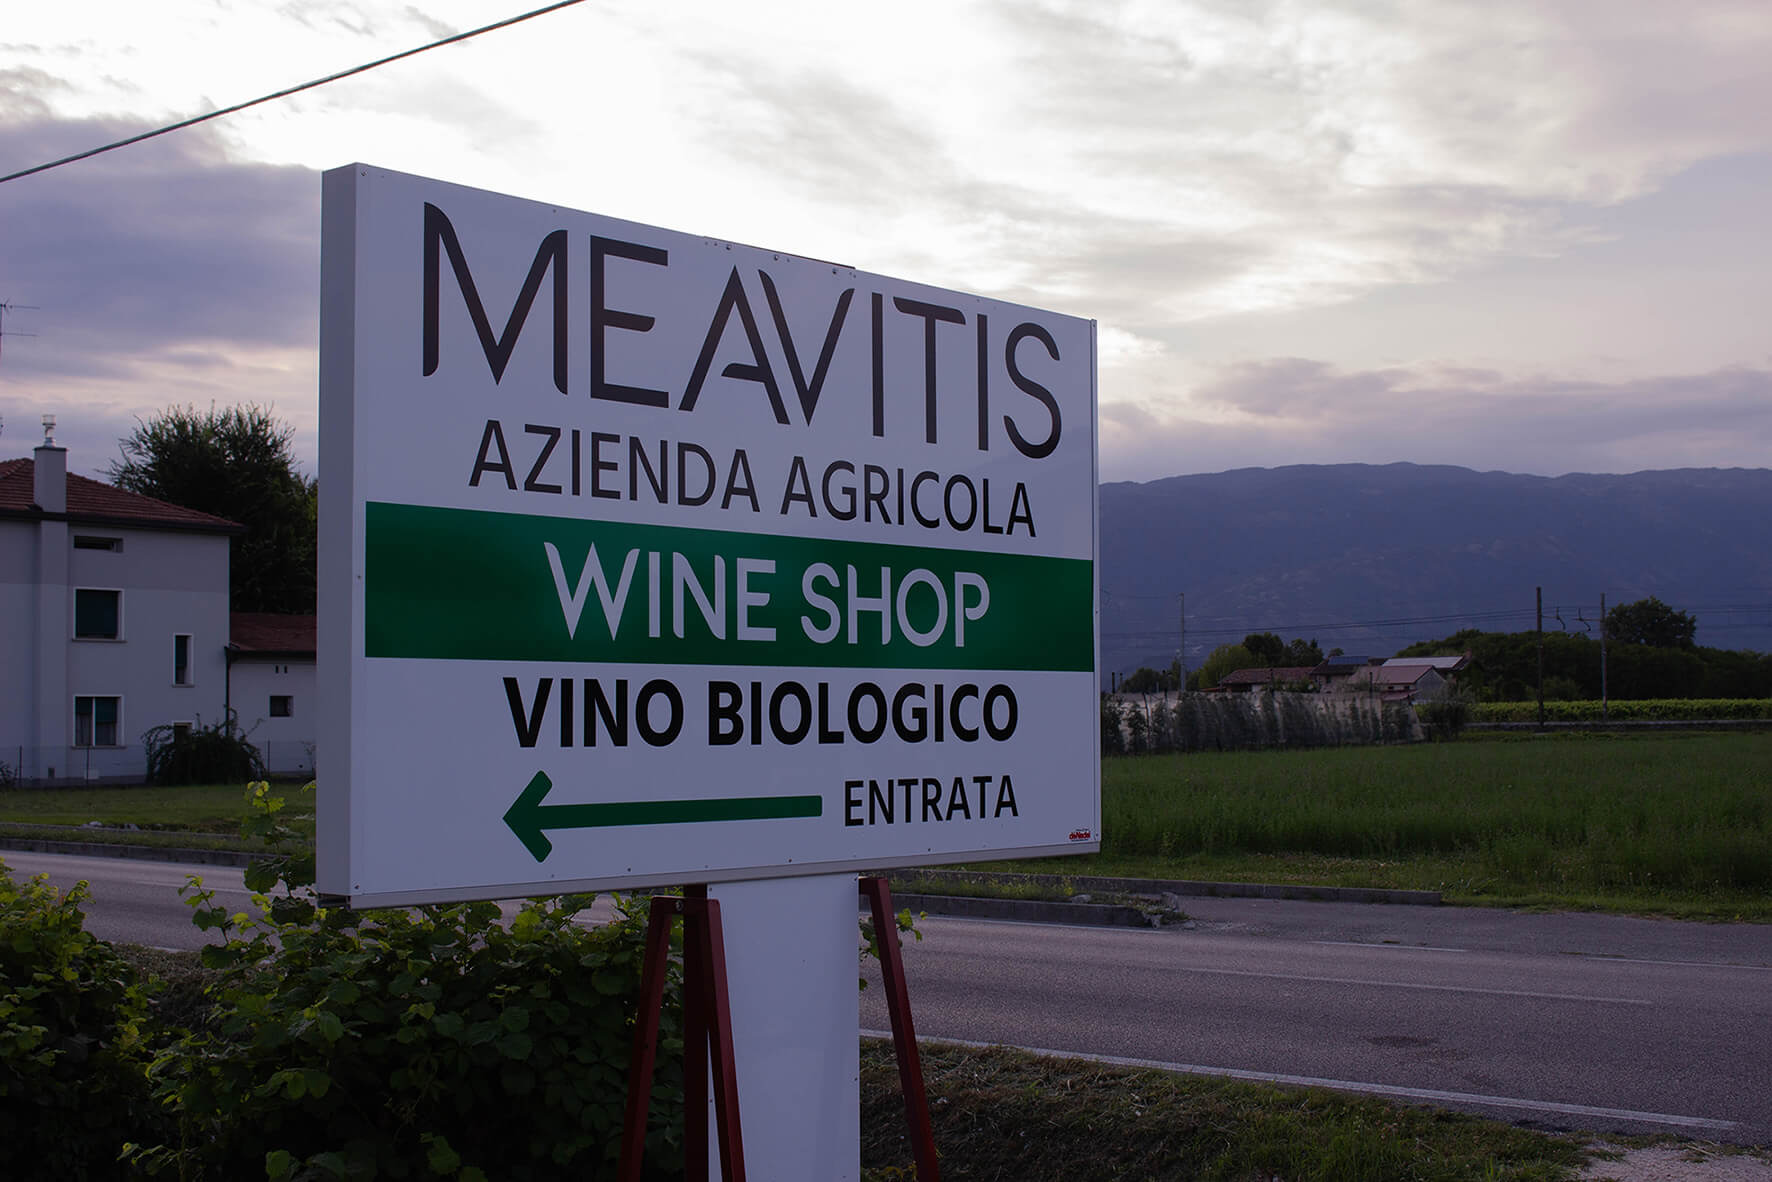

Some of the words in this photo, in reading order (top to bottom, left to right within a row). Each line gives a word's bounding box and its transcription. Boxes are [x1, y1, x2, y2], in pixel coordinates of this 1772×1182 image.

[423, 202, 1061, 459] MEAVITIS
[469, 420, 760, 512] AZIENDA
[781, 456, 1036, 537] AGRICOLA
[544, 542, 776, 641] WINE
[801, 563, 990, 647] SHOP
[503, 677, 683, 747] VINO
[709, 681, 1018, 745] BIOLOGICO
[845, 775, 1018, 826] ENTRATA
